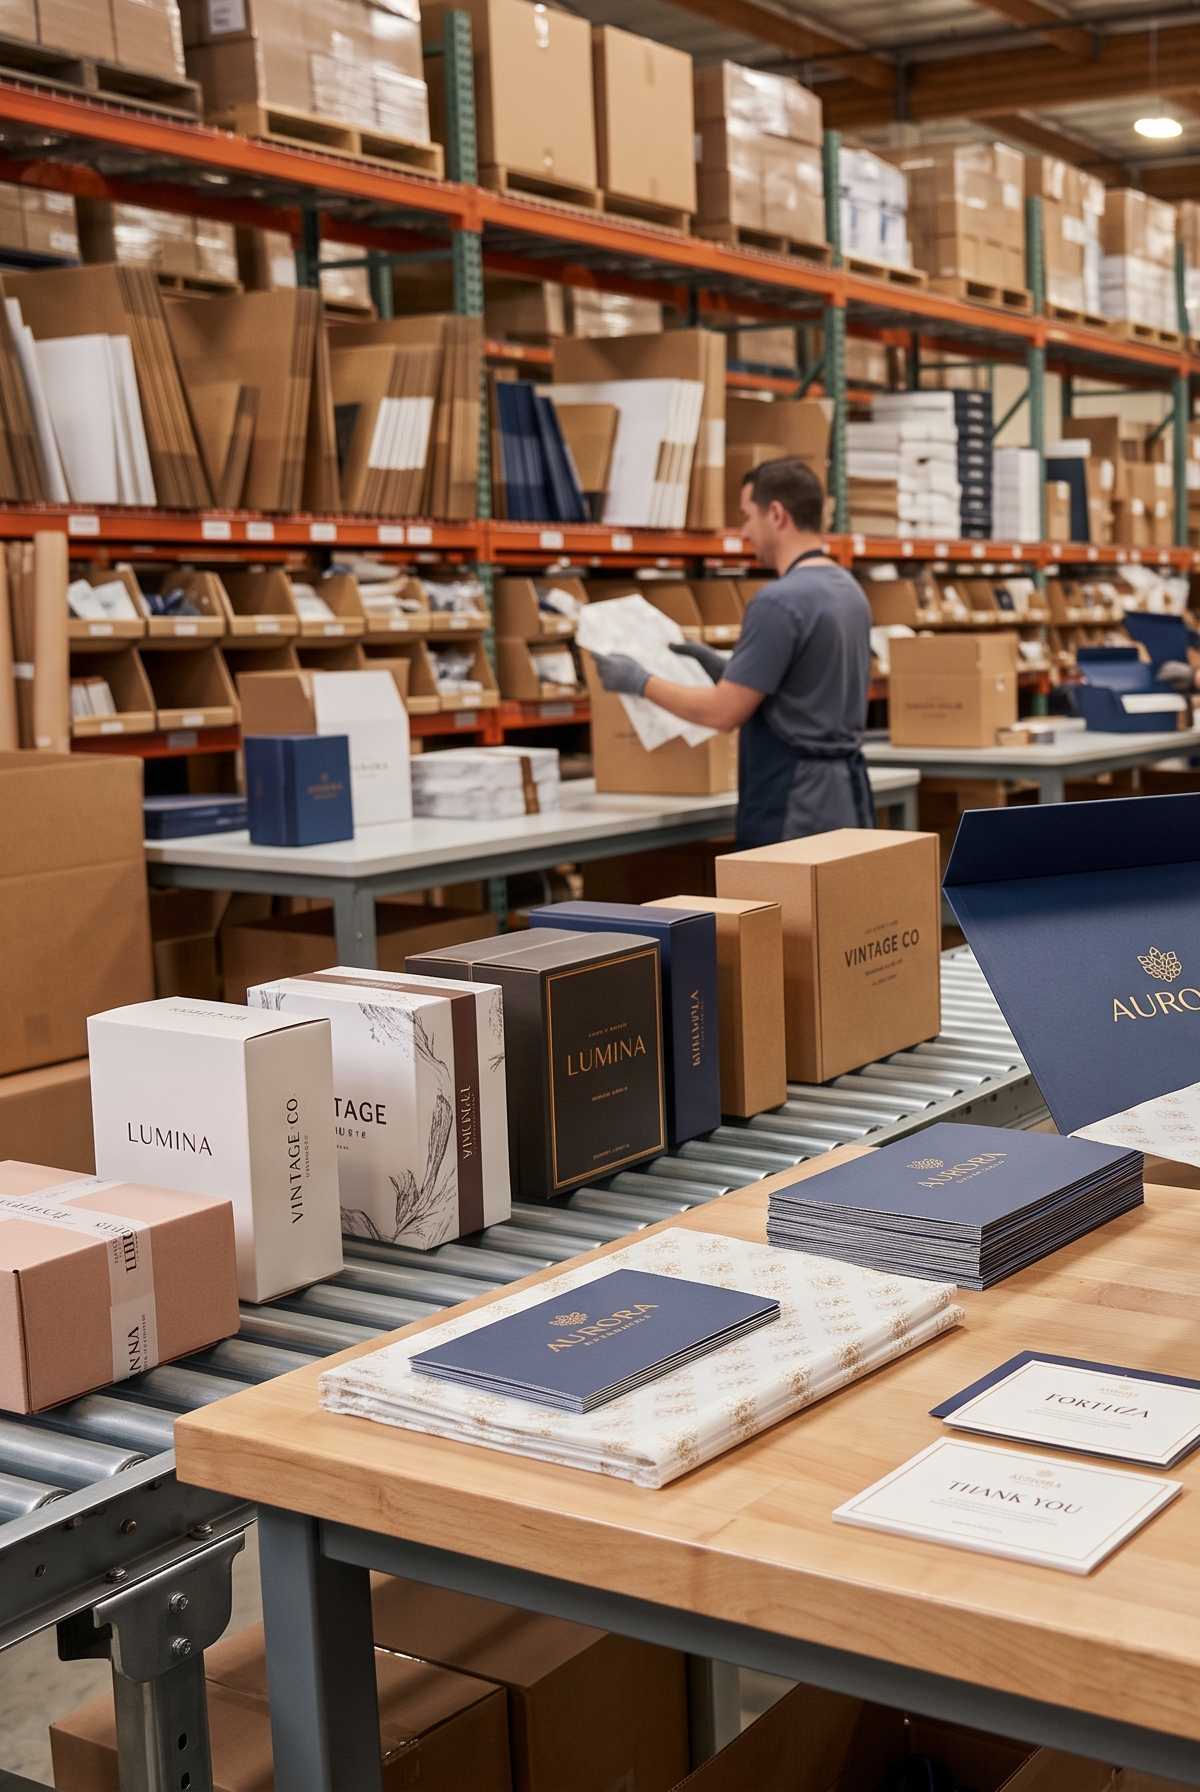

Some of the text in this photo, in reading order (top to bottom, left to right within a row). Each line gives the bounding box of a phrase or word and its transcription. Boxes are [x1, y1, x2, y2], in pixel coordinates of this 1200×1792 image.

[844, 934, 898, 968] VINTAGE
[902, 928, 920, 948] CO
[566, 1034, 647, 1077] LUMINA
[333, 1097, 387, 1125] TAGE
[127, 1122, 213, 1156] LUMINA
[287, 1131, 304, 1224] VINTAGE
[546, 1303, 660, 1353] AURORA
[948, 1480, 1028, 1504] THANK
[1033, 1497, 1083, 1515] YOU
